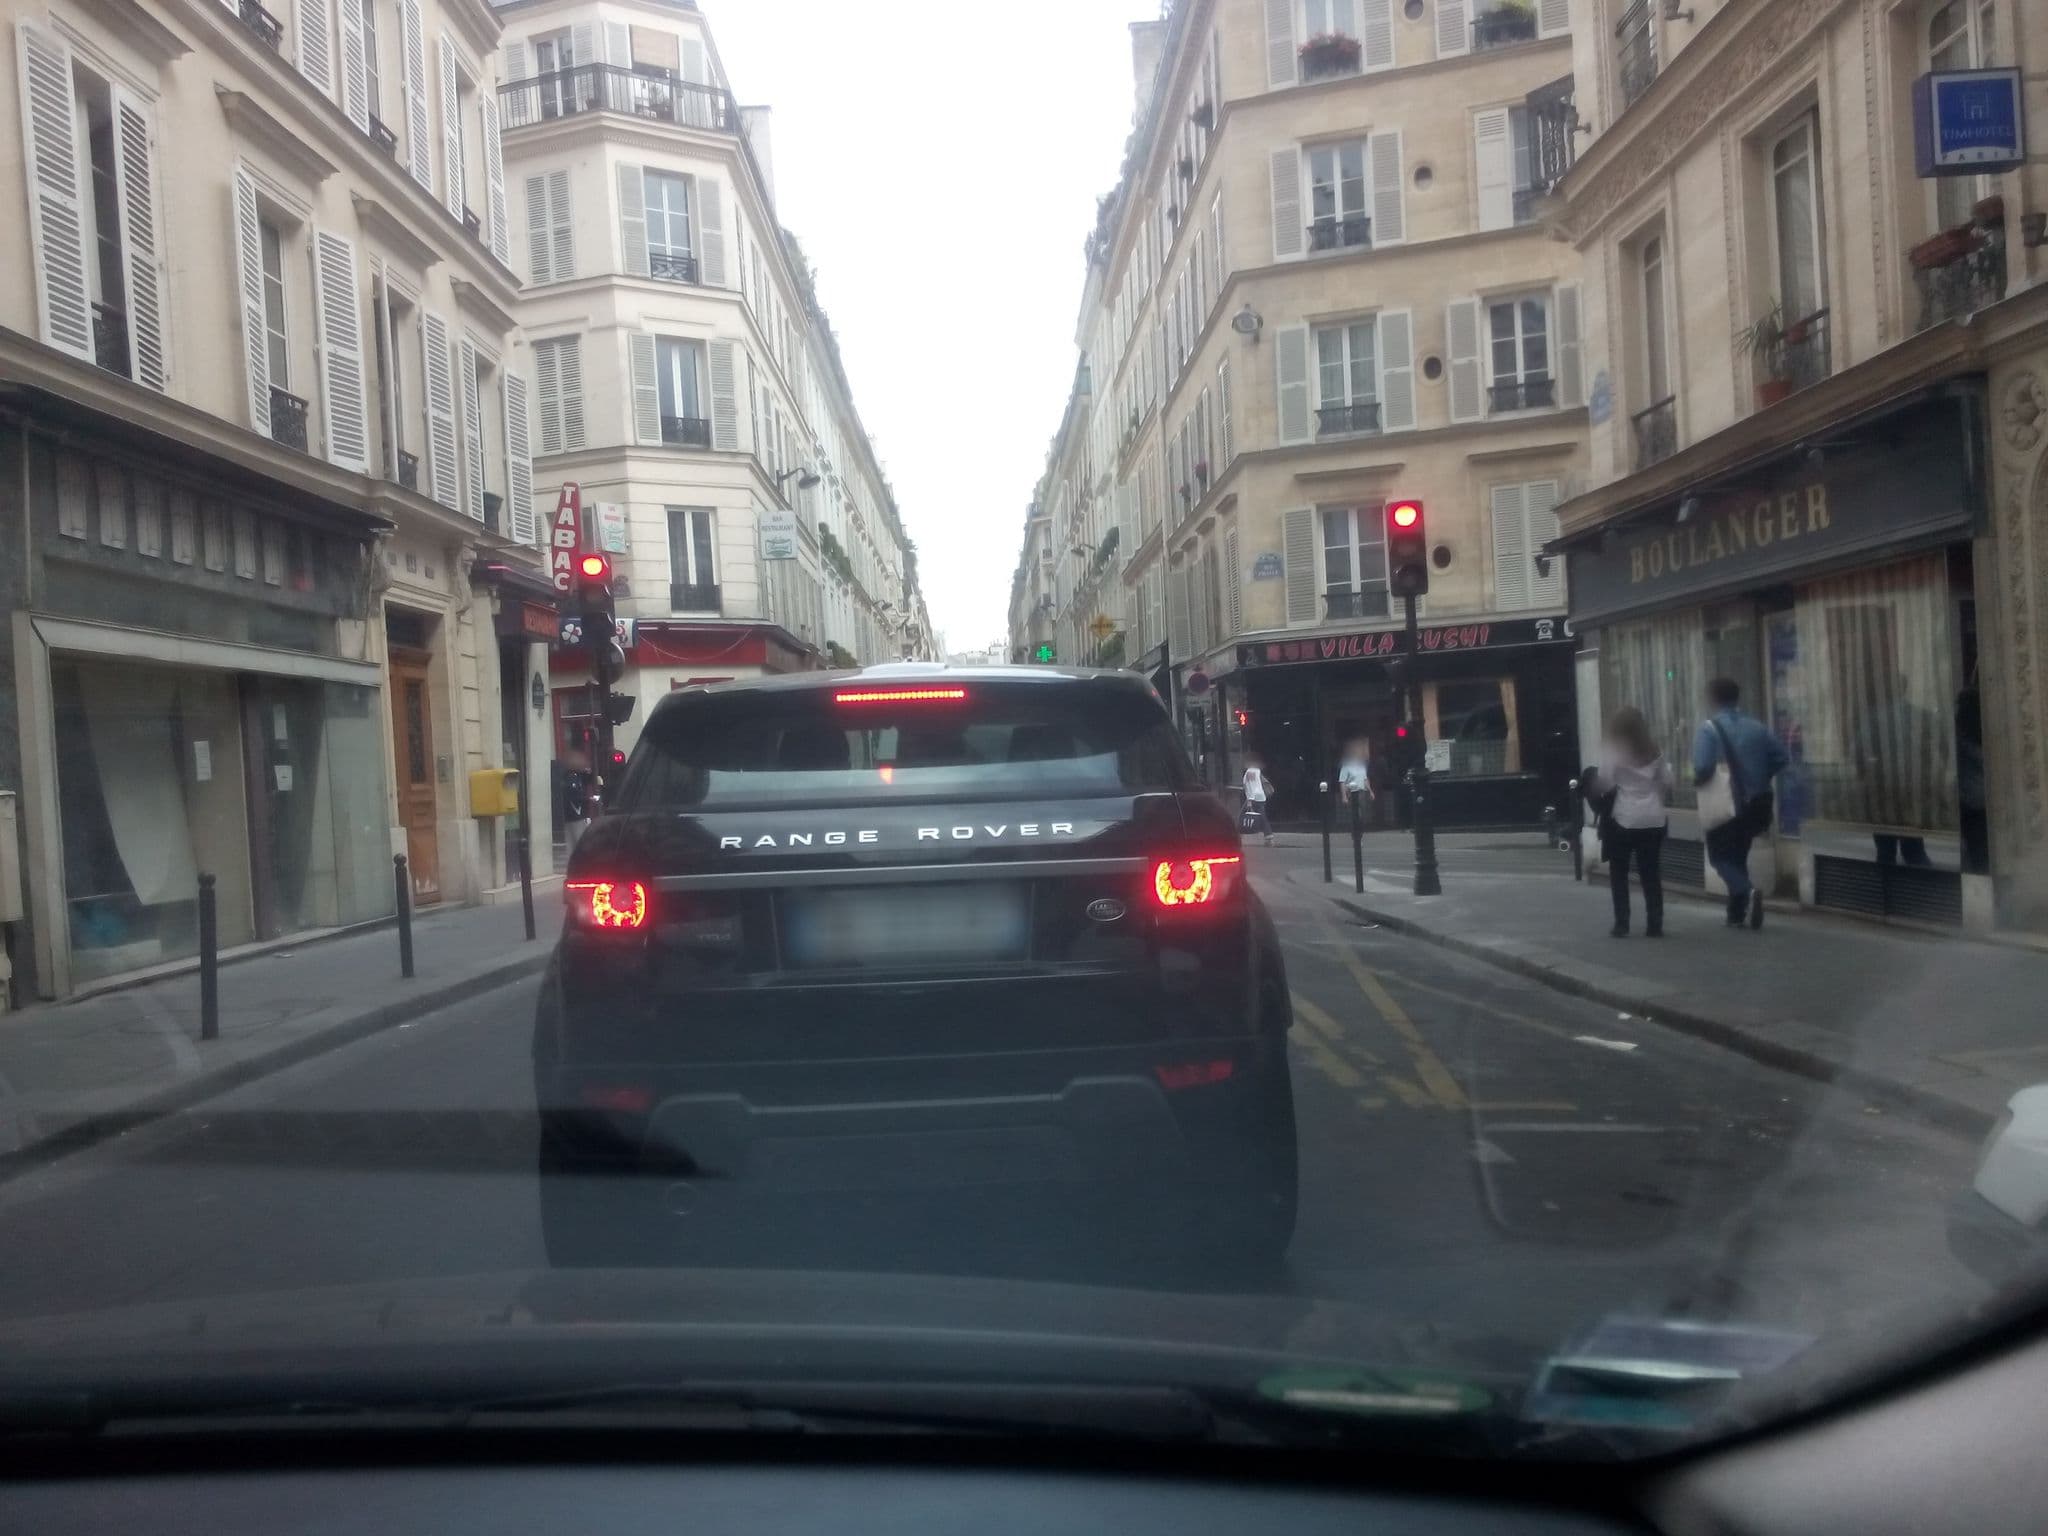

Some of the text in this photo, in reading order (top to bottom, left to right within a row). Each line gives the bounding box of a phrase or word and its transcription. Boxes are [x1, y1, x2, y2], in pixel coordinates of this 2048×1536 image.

[1942, 150, 2016, 162] PARIS
[554, 486, 576, 591] TABAC
[1630, 484, 1830, 584] BOULANGER
[1320, 632, 1394, 658] VILLA
[720, 822, 1073, 849] RANGE ROVER
